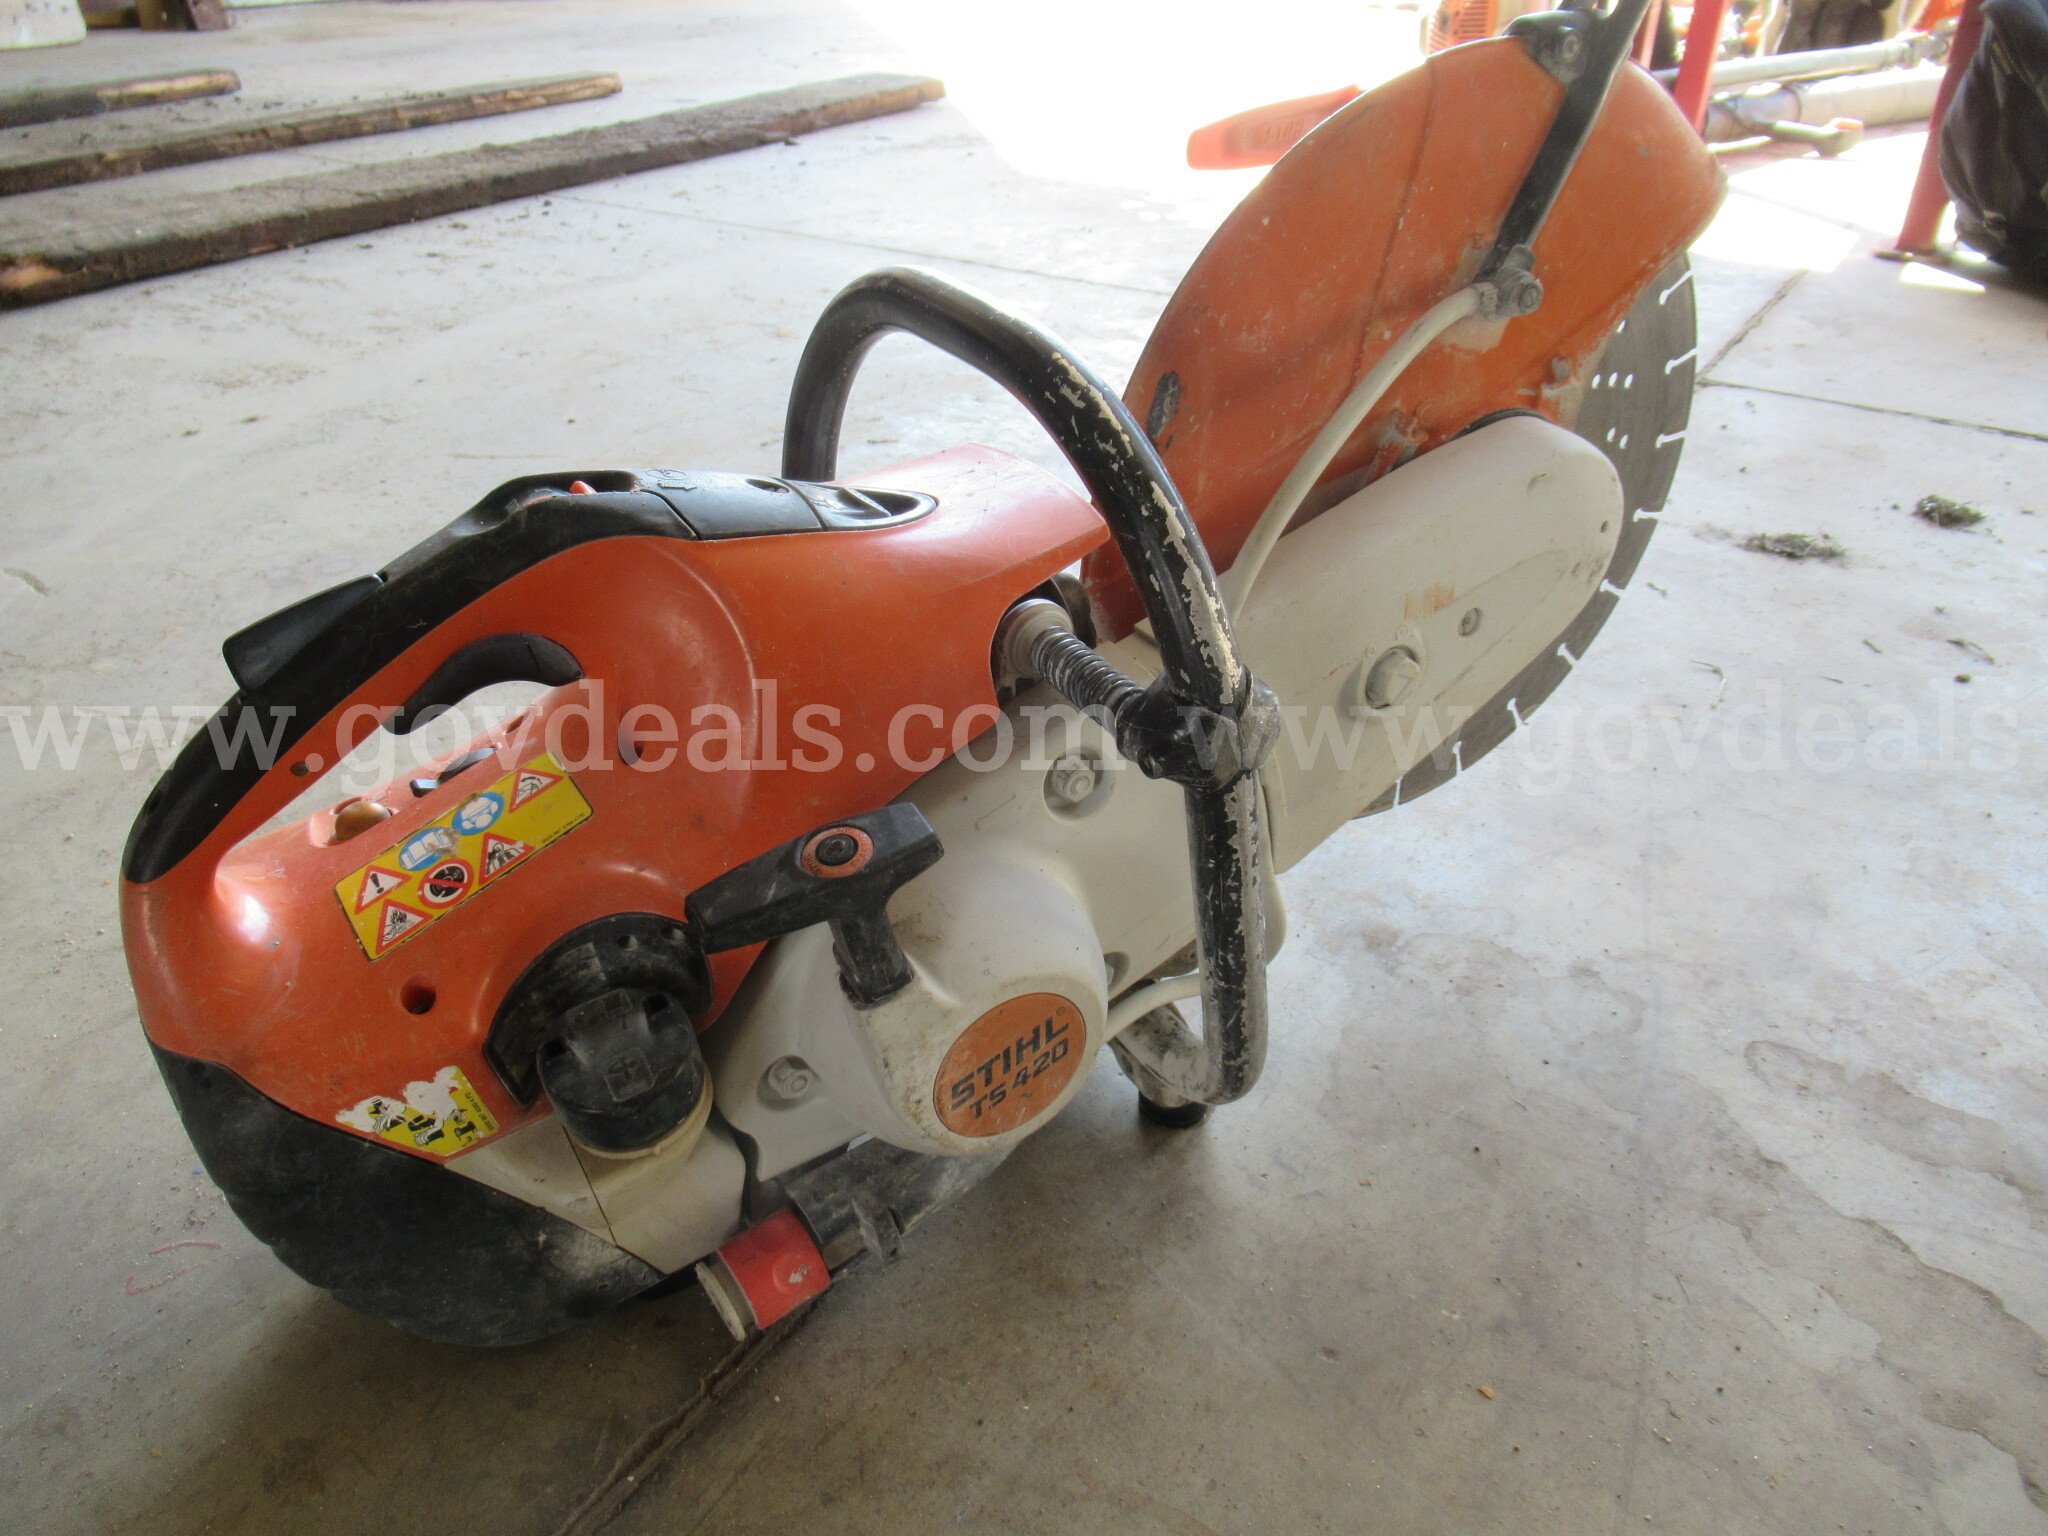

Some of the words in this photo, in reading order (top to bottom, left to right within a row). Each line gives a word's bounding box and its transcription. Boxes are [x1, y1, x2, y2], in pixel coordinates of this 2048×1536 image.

[950, 1015, 1070, 1112] STIHL
[969, 1081, 1008, 1119] TS
[1011, 1037, 1070, 1090] 420
